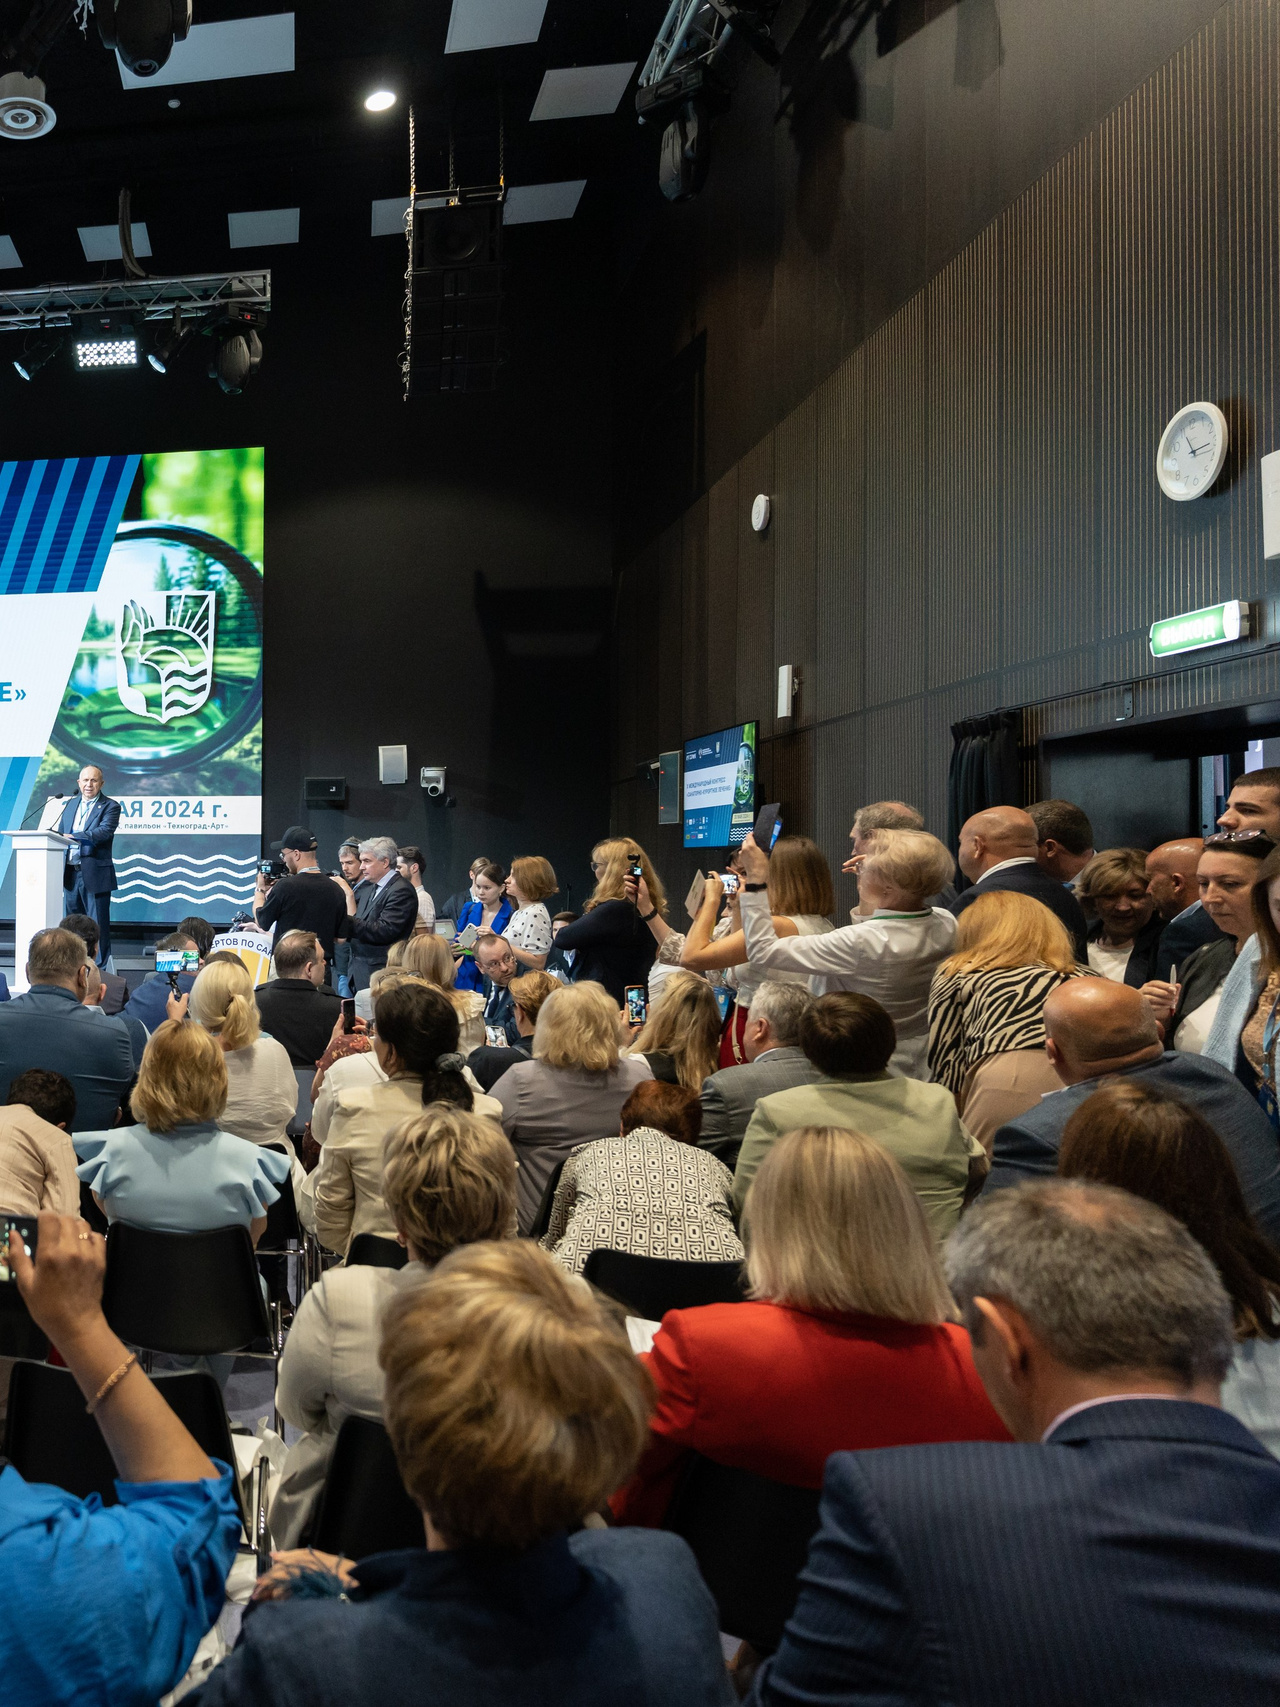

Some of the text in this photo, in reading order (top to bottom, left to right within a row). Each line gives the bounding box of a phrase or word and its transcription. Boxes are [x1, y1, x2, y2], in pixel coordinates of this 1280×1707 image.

[1188, 417, 1196, 430] 12
[1207, 422, 1214, 435] 2
[1175, 469, 1181, 481] 8
[1193, 475, 1199, 486] 6
[1160, 615, 1216, 647] ВЫХОД
[120, 800, 228, 818] АЯ 2024 г.
[163, 822, 229, 831] «Техноград-Арт»
[241, 939, 255, 948] ПО
